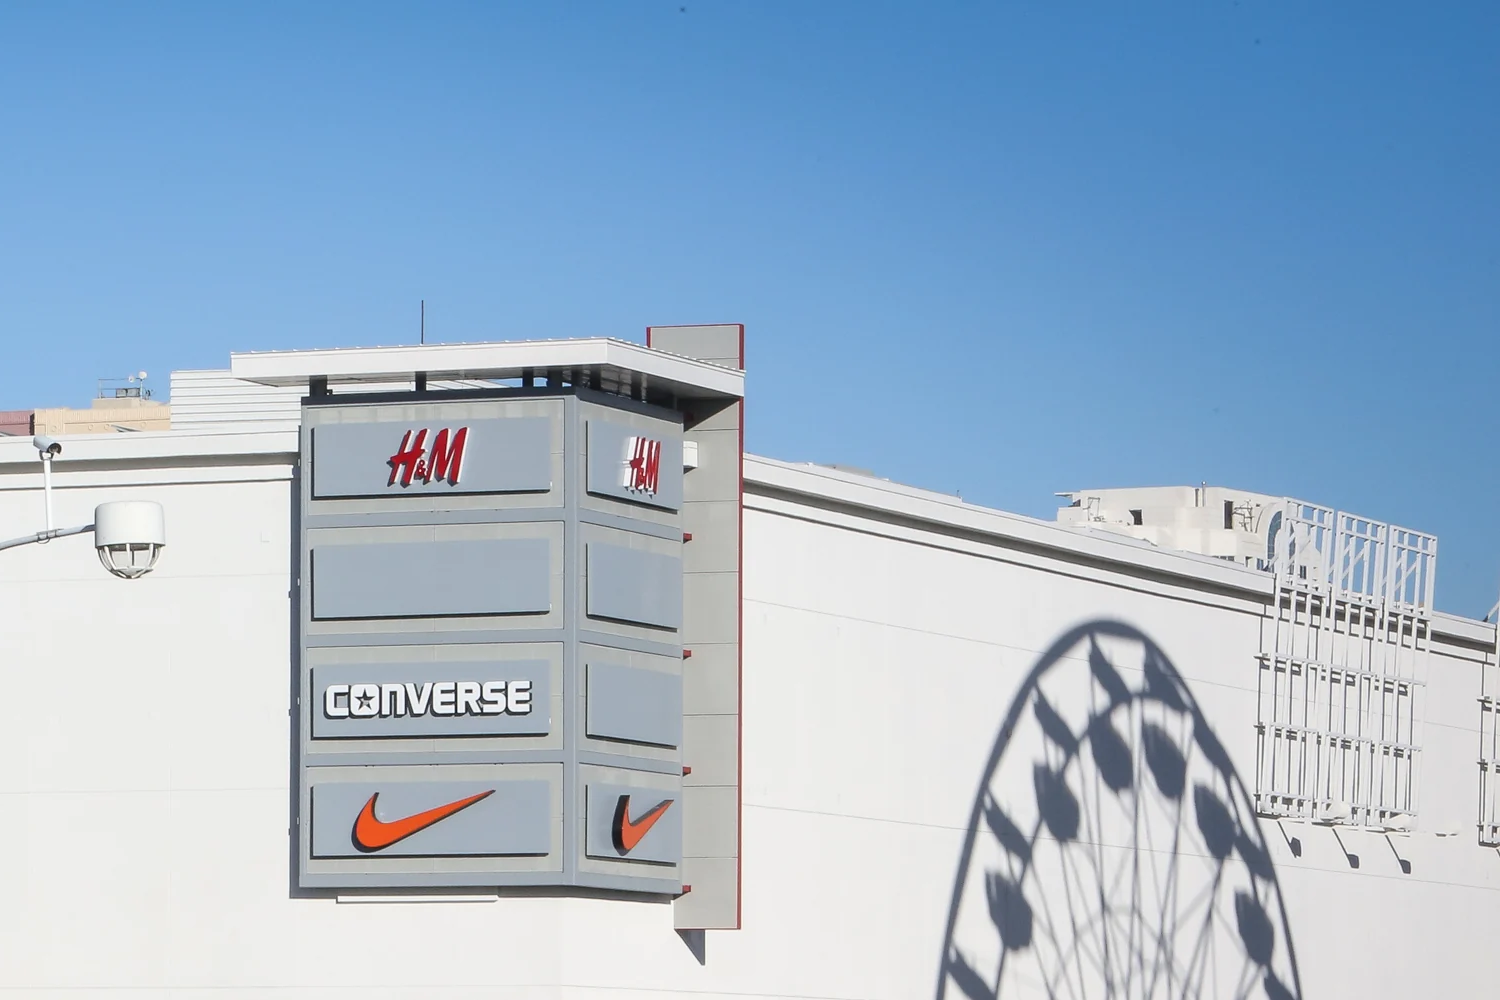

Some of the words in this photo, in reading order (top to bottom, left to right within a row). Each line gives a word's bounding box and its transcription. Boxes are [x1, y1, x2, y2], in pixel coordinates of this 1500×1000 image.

[386, 426, 471, 487] H&M
[625, 434, 661, 496] H&M
[323, 680, 532, 719] CONVERSE
